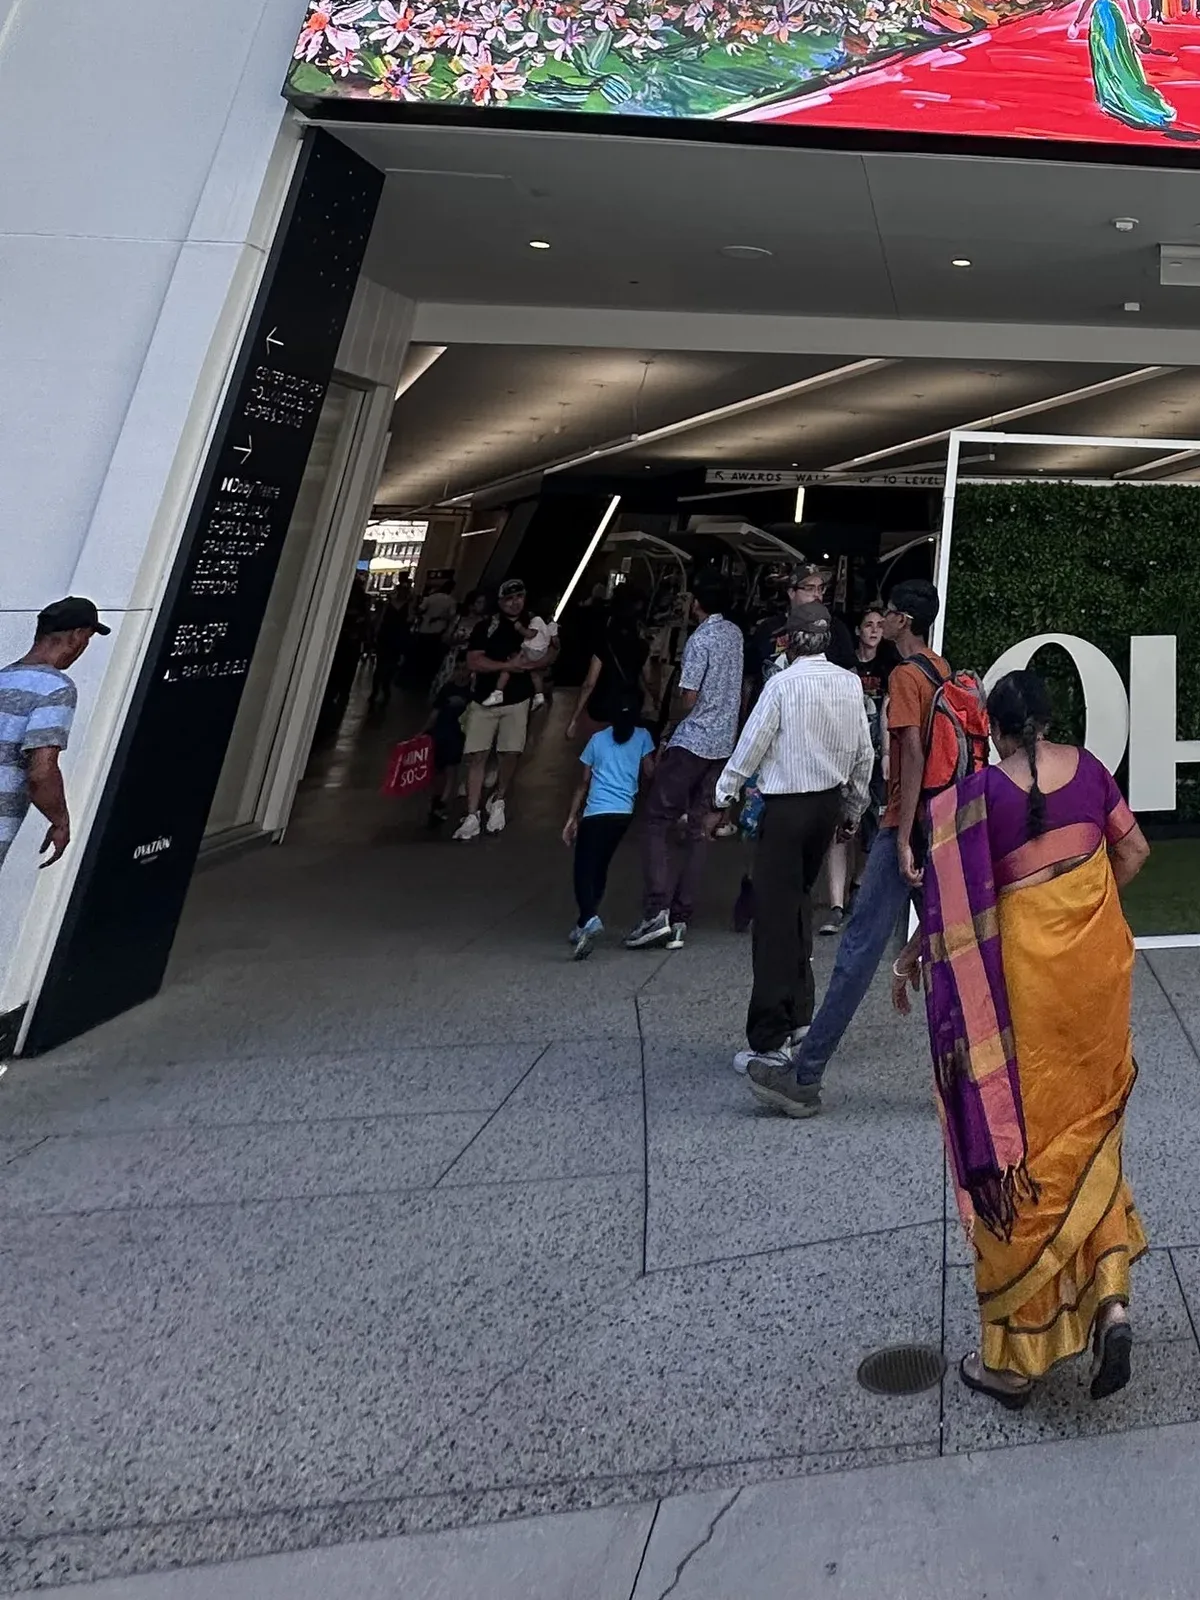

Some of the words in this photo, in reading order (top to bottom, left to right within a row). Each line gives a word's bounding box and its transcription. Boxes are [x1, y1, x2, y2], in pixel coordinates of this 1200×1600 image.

[731, 472, 782, 482] AWARDS
[883, 475, 897, 485] TO
[905, 476, 941, 486] LEVEL
